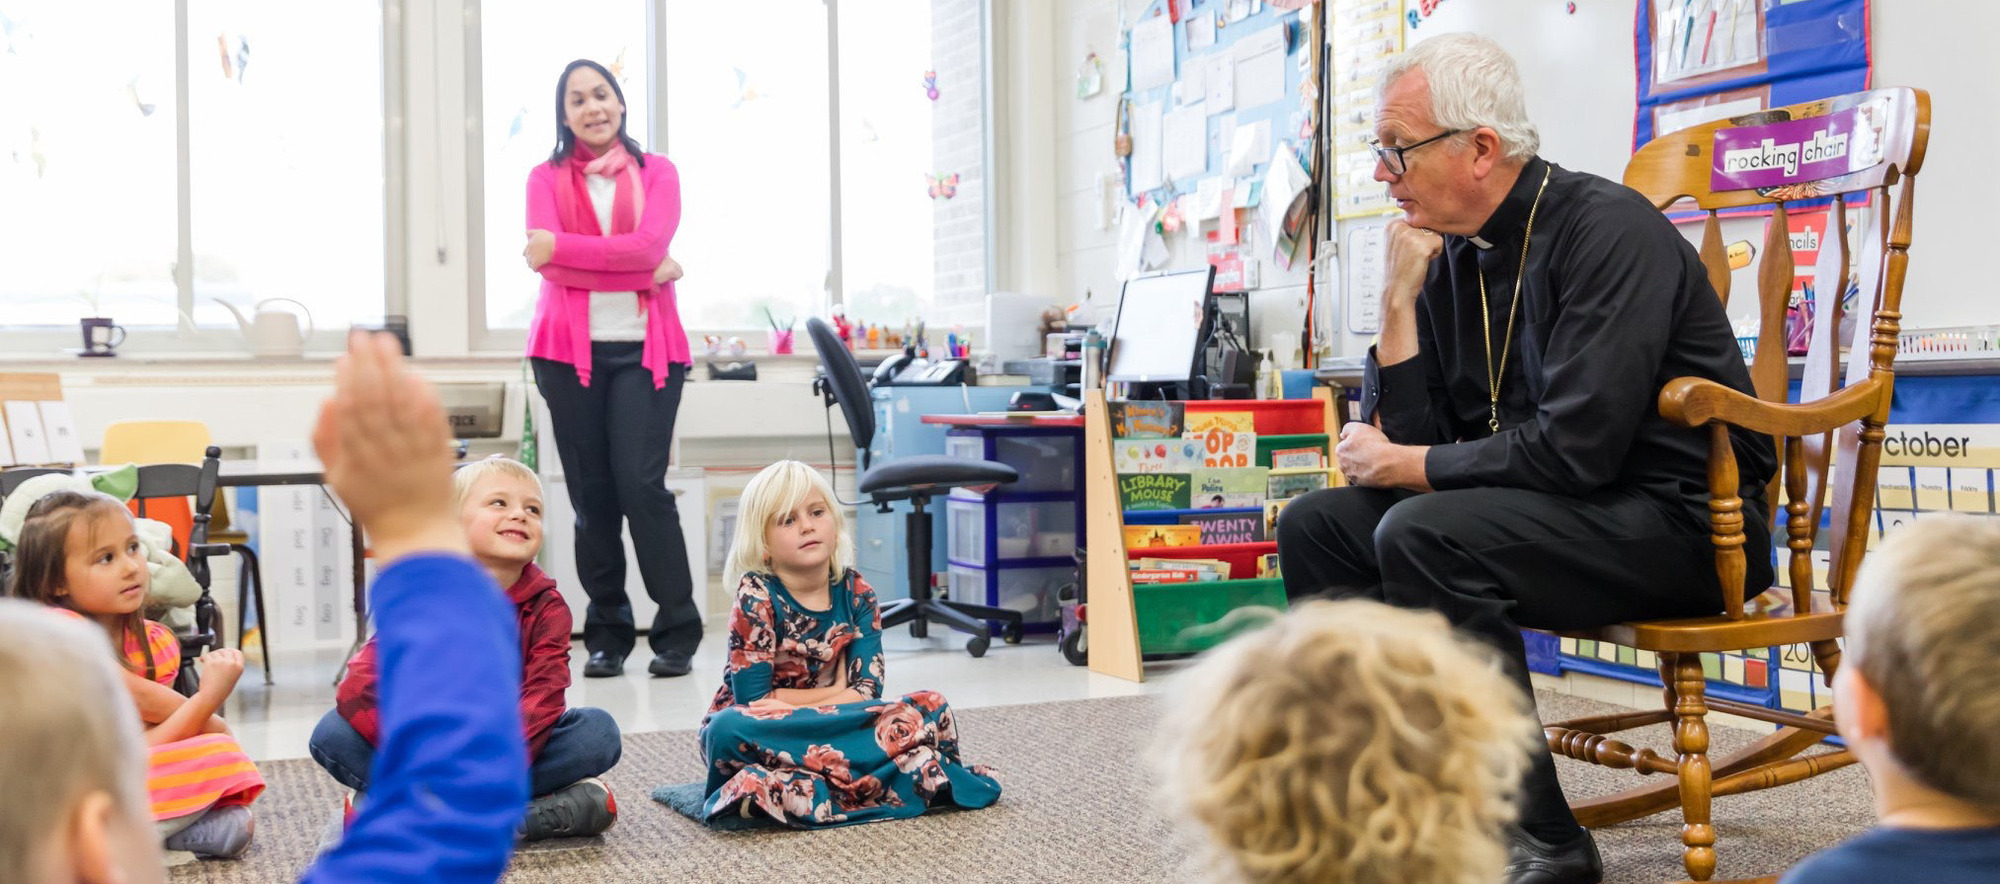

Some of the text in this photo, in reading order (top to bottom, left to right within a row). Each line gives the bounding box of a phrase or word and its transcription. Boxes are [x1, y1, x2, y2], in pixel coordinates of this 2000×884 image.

[1727, 137, 1844, 174] rocking chair
[1789, 231, 1817, 249] ncils
[1884, 431, 1970, 458] ctober
[1121, 475, 1186, 493] LIBRARY
[1130, 488, 1175, 503] MOUSE
[1784, 642, 1809, 663] 20
